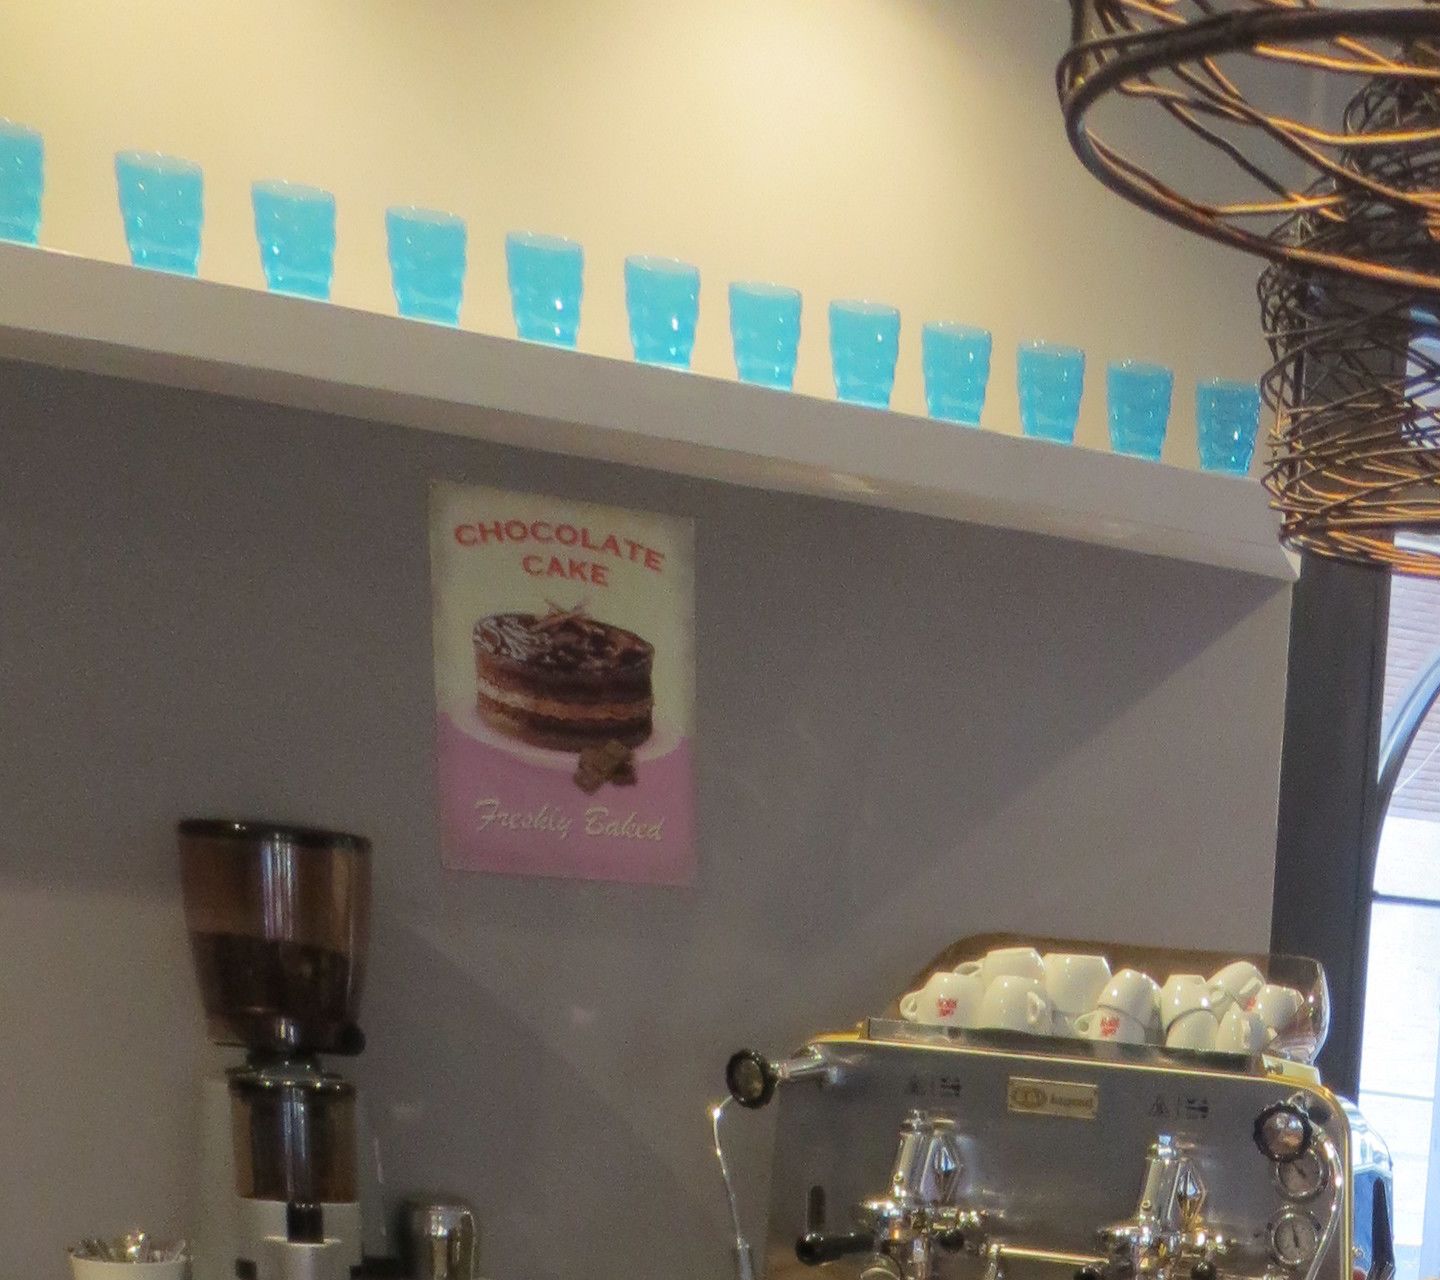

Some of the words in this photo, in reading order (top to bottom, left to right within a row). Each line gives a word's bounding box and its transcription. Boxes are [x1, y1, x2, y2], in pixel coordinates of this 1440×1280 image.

[454, 519, 665, 573] CHOCOLATE
[522, 554, 609, 587] CAKE
[474, 799, 573, 840] Freshly
[585, 806, 665, 841] Baked
